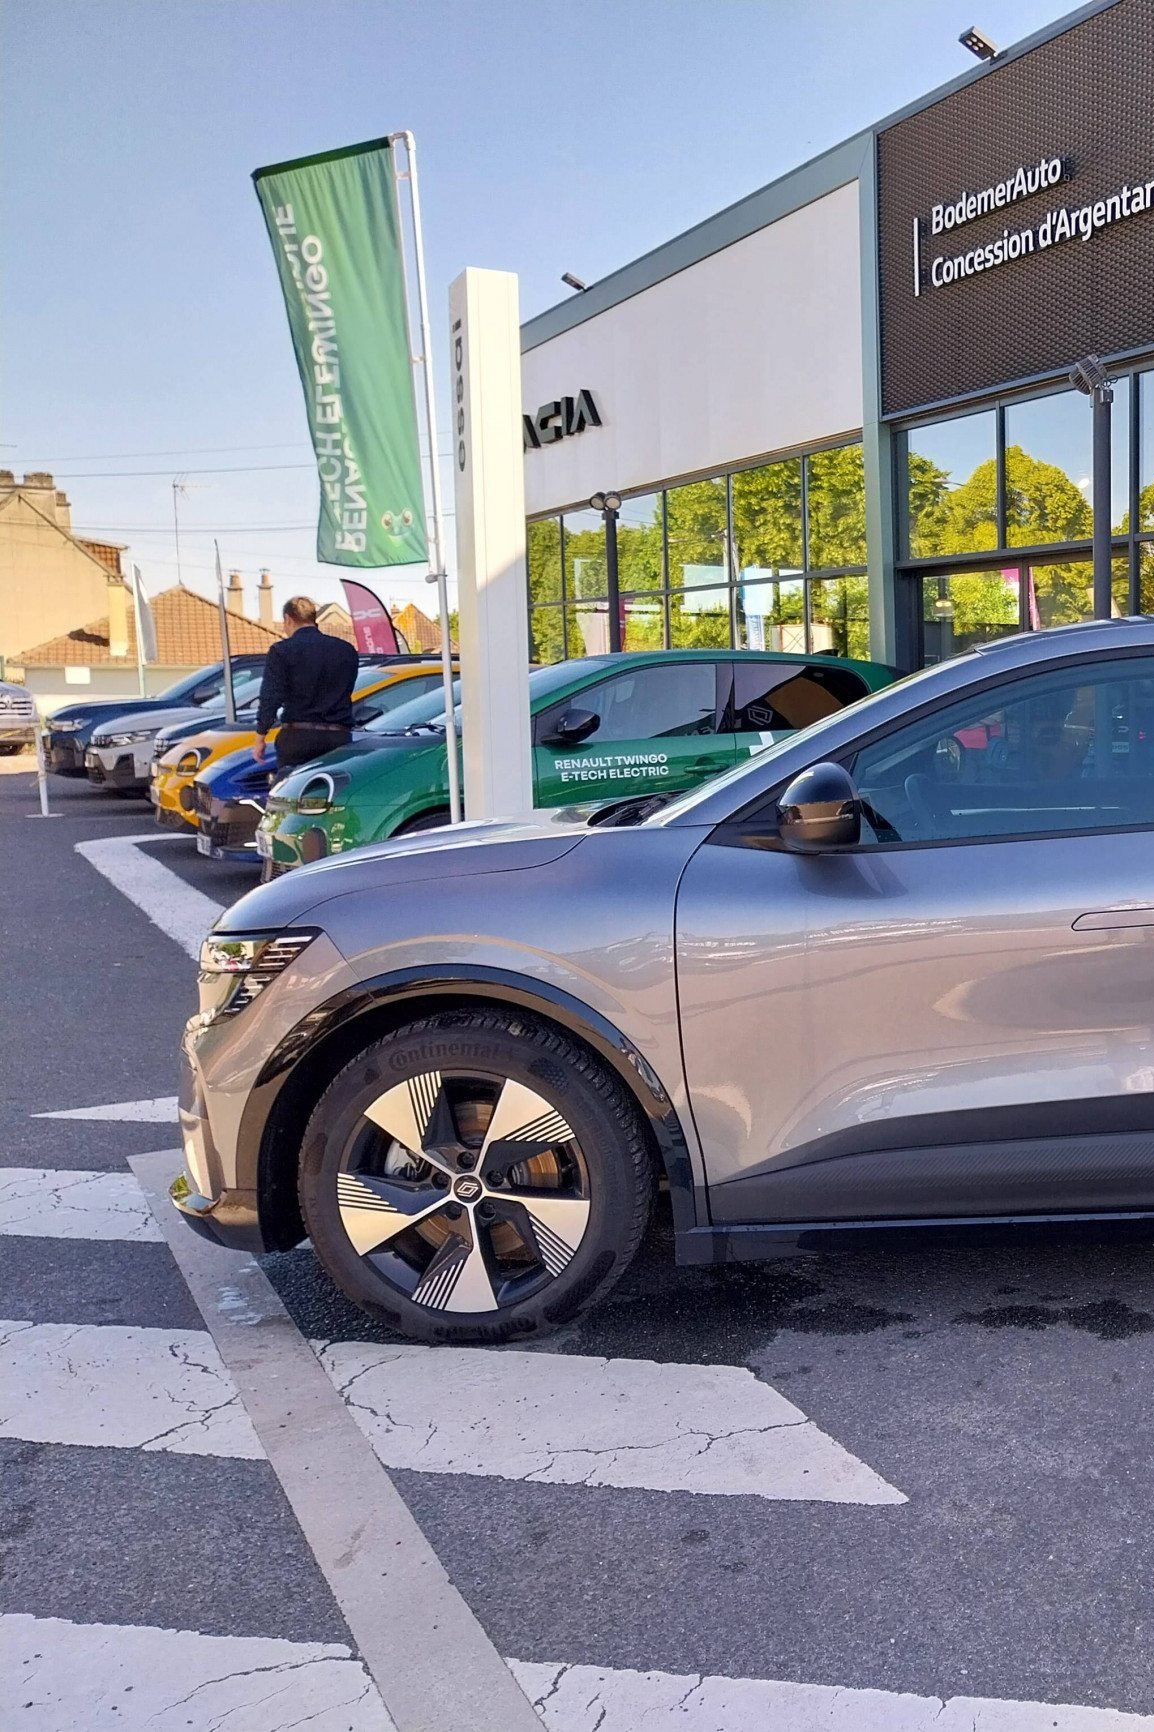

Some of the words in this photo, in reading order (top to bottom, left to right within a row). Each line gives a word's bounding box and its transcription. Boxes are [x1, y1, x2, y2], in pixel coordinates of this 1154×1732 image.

[932, 158, 1061, 235] BodemerAuto
[932, 229, 1034, 288] Concession
[522, 389, 602, 453] ACIA
[554, 757, 613, 770] RENAULT
[614, 753, 668, 766] TWINGO
[561, 769, 607, 782] E-TECH
[609, 765, 669, 779] ELECTRIC
[388, 1040, 499, 1071] Continental
